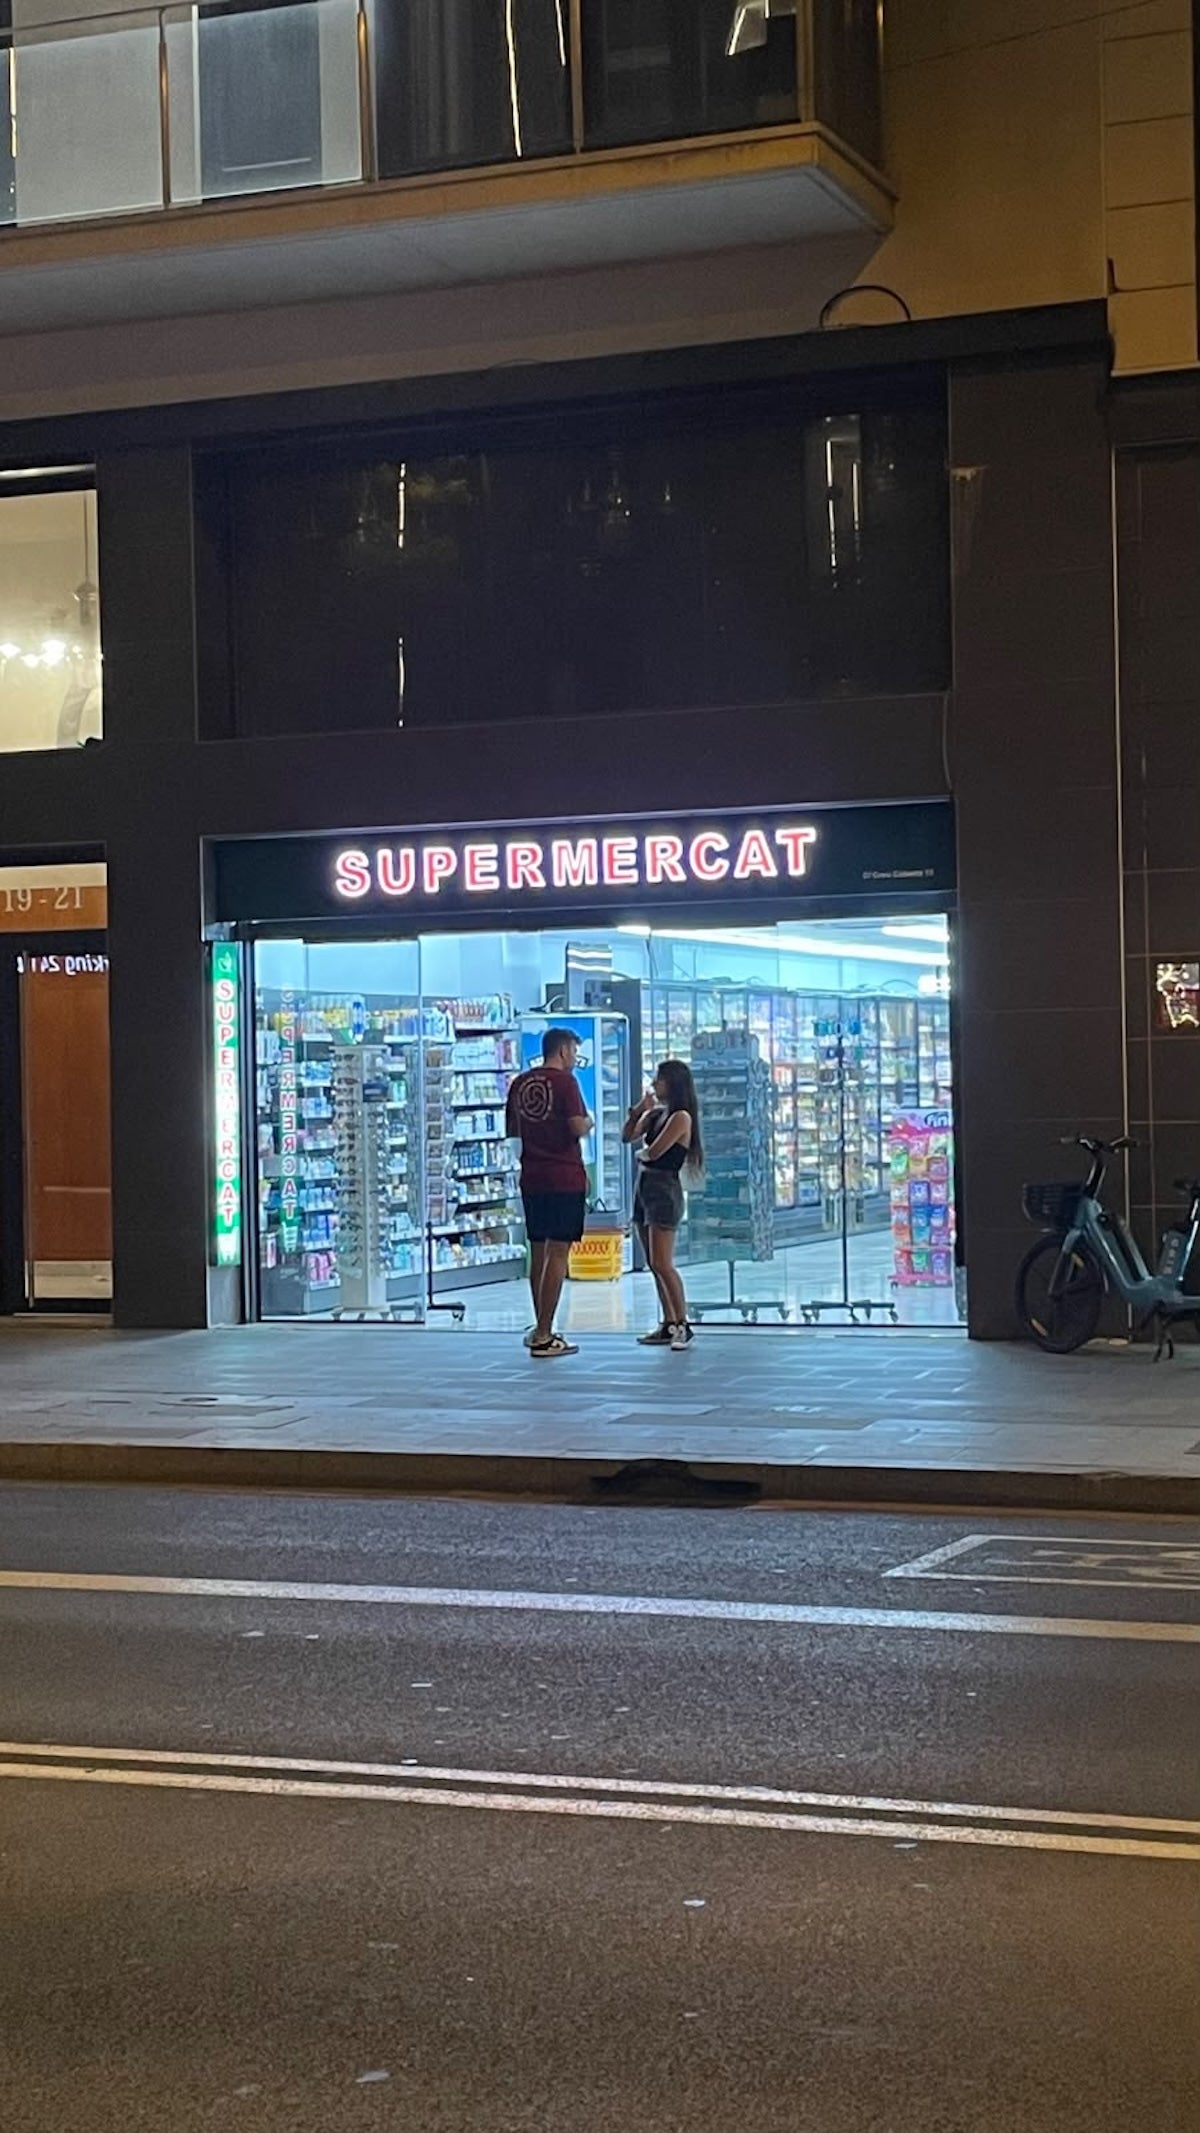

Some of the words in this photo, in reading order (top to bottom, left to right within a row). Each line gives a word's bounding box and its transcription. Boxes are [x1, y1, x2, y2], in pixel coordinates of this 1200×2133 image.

[335, 827, 817, 898] SUPERMERCAT
[5, 888, 33, 912] 19
[54, 886, 83, 910] 21
[217, 980, 237, 1226] SUPERMERCAT
